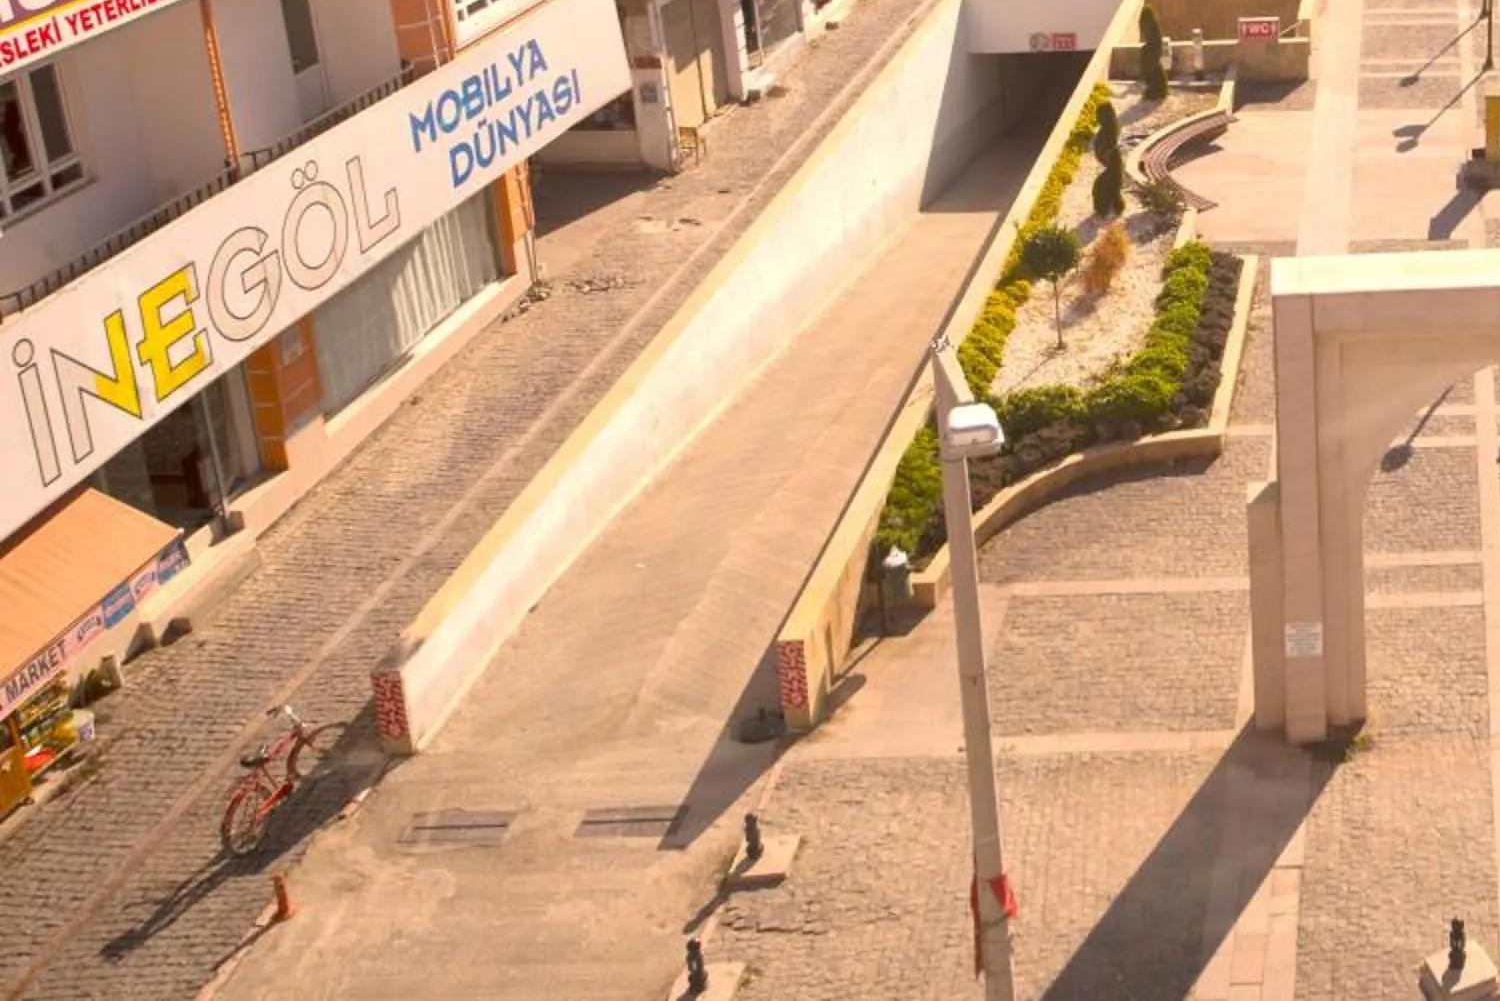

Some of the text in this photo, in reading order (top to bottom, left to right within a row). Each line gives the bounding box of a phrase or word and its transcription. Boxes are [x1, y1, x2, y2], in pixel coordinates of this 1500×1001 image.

[0, 15, 62, 66] SLEKİ
[449, 68, 581, 188] DÜNYASI
[12, 156, 402, 487] İNEGÖL
[5, 640, 67, 702] MARKET
